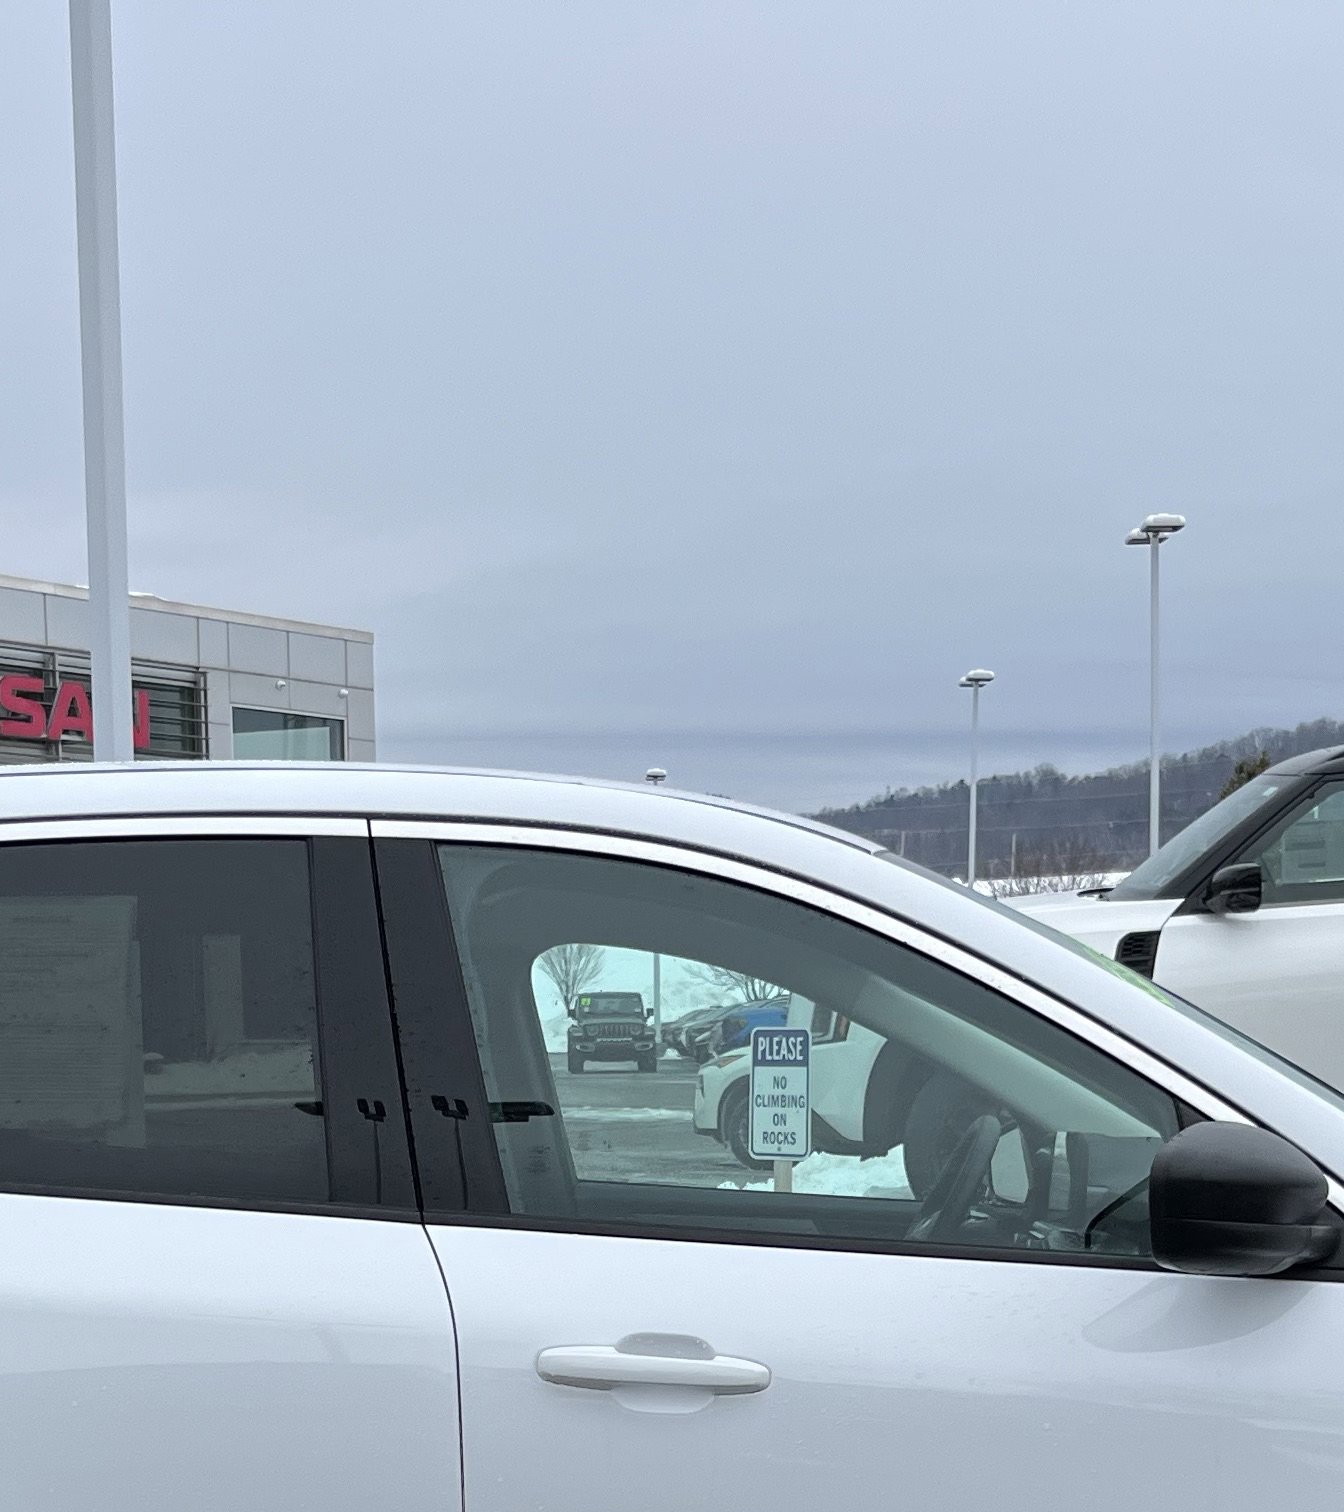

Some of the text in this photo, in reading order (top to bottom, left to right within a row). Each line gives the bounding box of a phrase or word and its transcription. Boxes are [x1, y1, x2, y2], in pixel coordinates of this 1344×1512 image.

[757, 1036, 804, 1061] PLEASE
[773, 1076, 787, 1090] NO
[755, 1094, 806, 1109] CLIMBING
[772, 1113, 787, 1127] ON
[762, 1131, 797, 1146] ROCKS
